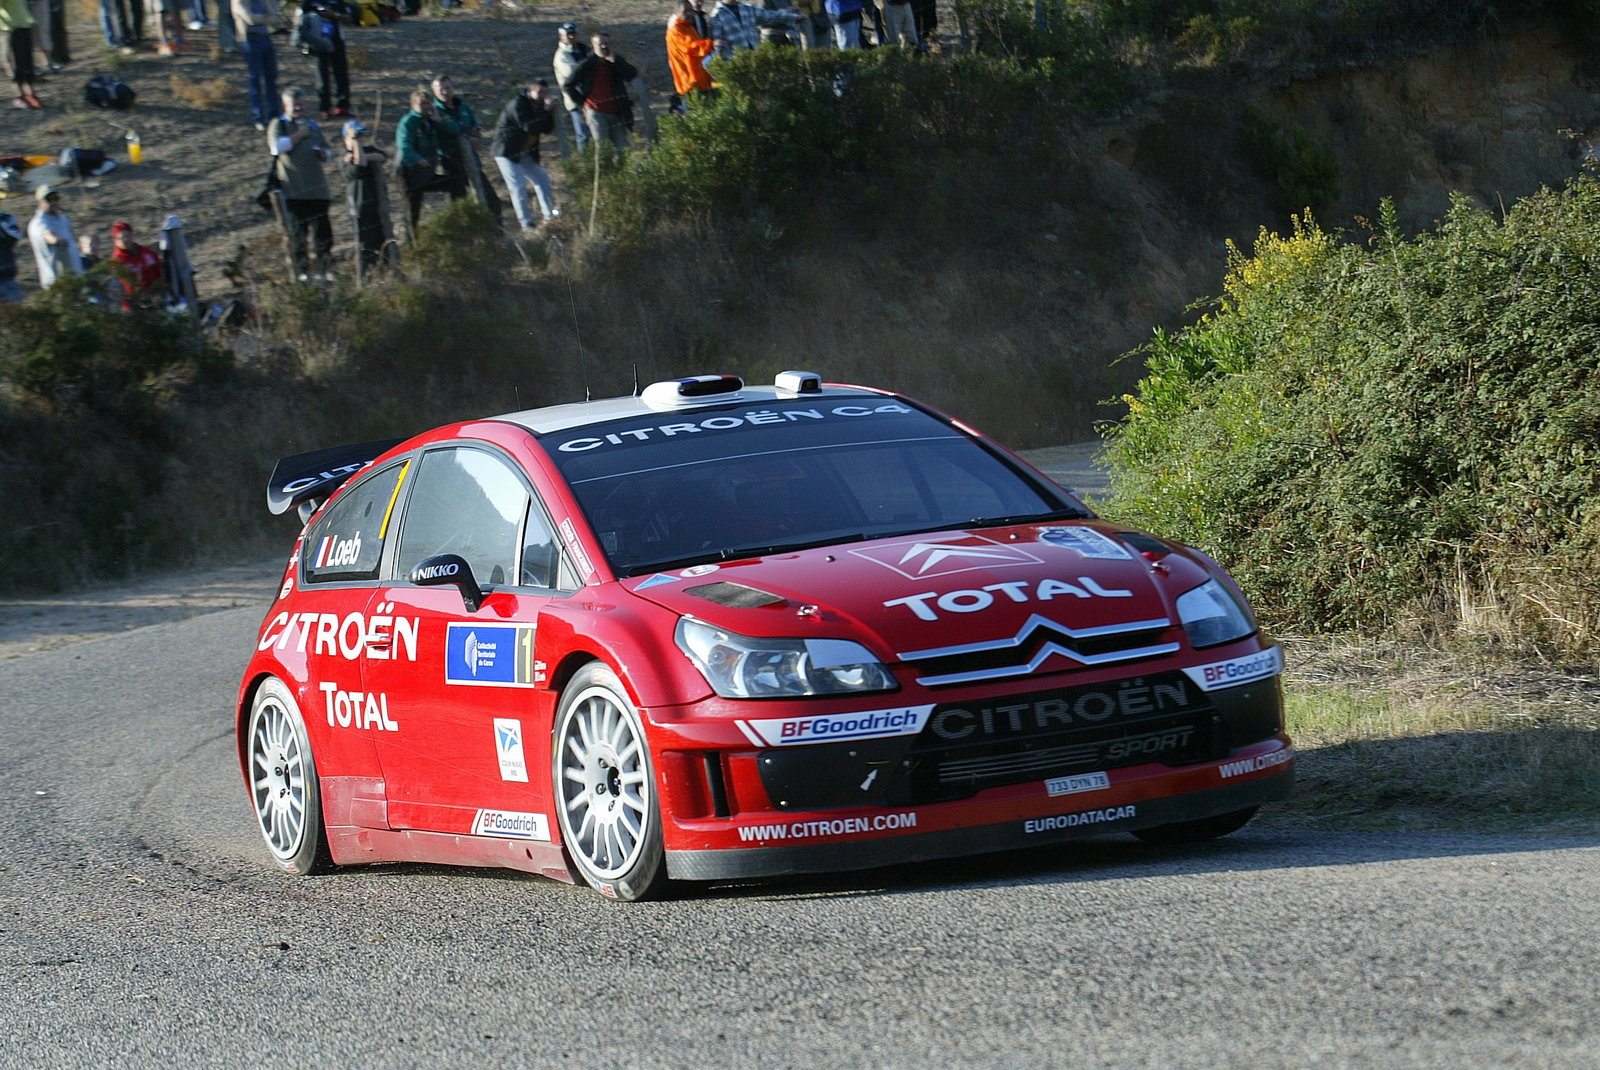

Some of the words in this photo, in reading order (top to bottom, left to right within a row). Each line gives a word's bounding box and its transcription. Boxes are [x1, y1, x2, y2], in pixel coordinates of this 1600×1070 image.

[558, 409, 825, 452] CITROËN
[831, 404, 913, 417] C4
[326, 531, 361, 566] Loeb
[417, 563, 459, 580] NIKKO
[883, 576, 1133, 621] TOTAL
[258, 601, 420, 662] CITROËN
[522, 628, 532, 683] 1
[1203, 653, 1275, 682] BFGoodrich
[319, 682, 398, 731] TOTAL
[931, 678, 1188, 740] CITROËN
[781, 710, 917, 737] BFGoodrich
[1105, 730, 1194, 760] SPORT
[484, 813, 537, 831] BFGoodrich
[738, 812, 917, 841] WWW.CITROEN.COM
[1024, 805, 1136, 833] EURODATACAR
